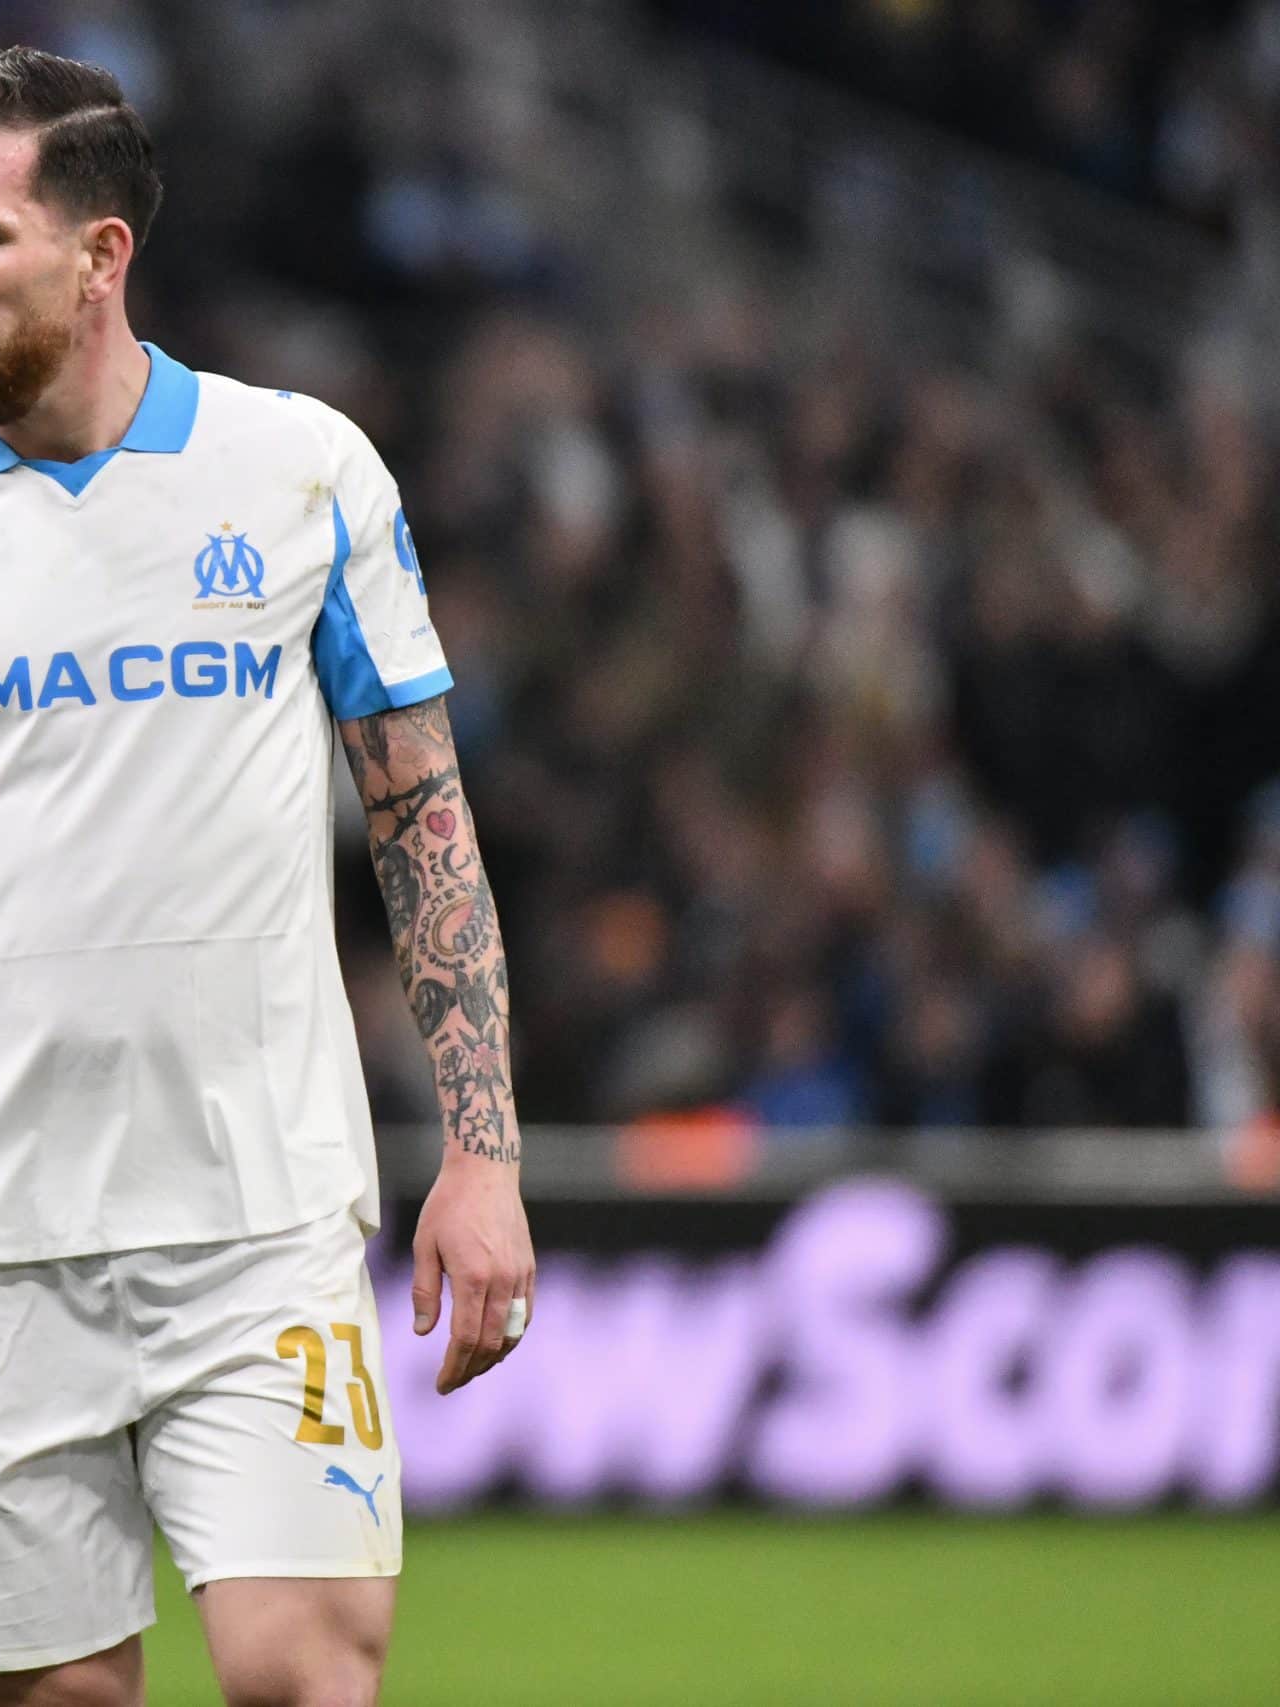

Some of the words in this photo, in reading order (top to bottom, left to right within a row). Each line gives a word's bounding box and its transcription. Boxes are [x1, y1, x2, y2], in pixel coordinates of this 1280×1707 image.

[246, 601, 266, 610] BUT
[108, 641, 283, 702] CGM
[275, 1322, 383, 1450] 23
